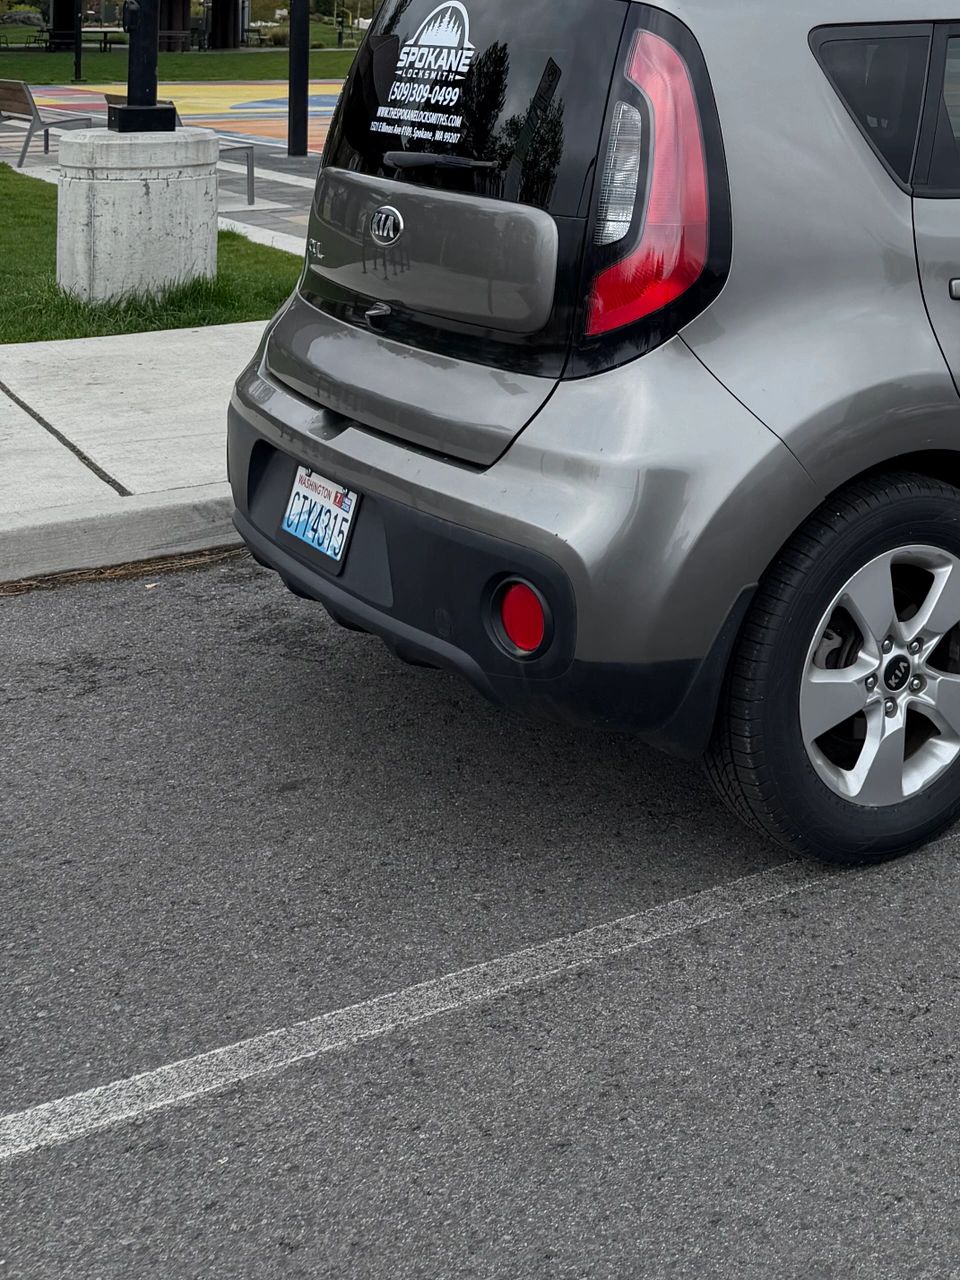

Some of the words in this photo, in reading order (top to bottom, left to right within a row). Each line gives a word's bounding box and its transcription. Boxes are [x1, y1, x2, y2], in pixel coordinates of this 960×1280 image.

[397, 47, 474, 73] SPOKANE
[402, 70, 454, 82] LOCKSMITH
[388, 81, 460, 106] (509)309-0499
[434, 130, 444, 141] WA
[443, 131, 460, 144] 99207
[372, 212, 395, 238] KIA
[298, 474, 333, 501] WASHINGTON
[286, 491, 349, 557] CTY4315
[888, 661, 908, 688] KIA
